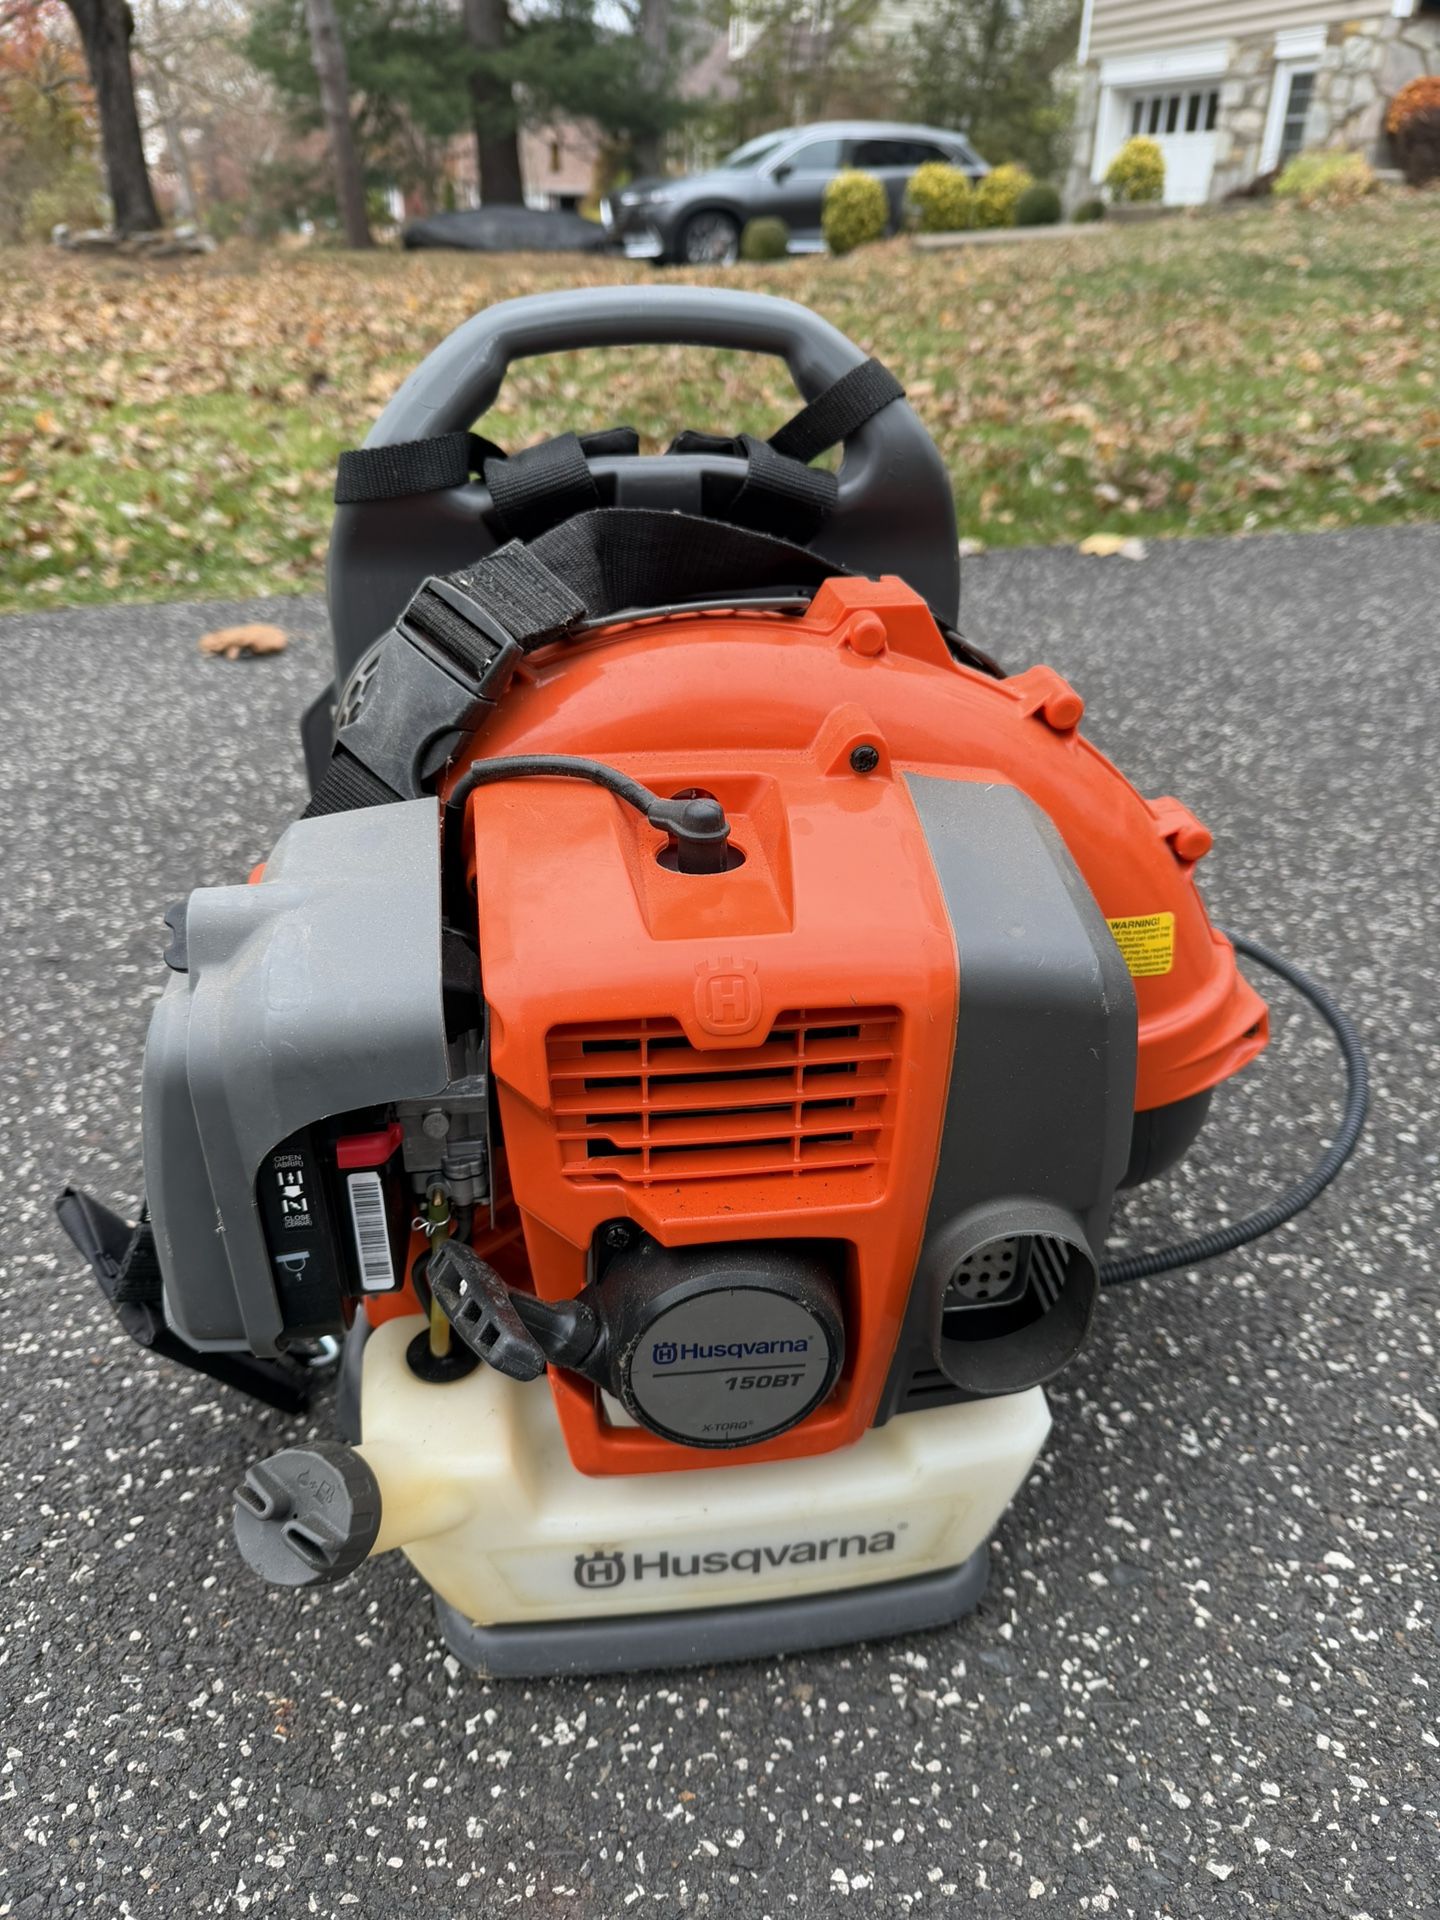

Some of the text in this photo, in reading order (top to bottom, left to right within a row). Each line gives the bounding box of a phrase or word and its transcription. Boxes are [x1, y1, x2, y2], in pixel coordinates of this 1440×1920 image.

[1111, 917, 1160, 929] WARNING!
[680, 1338, 808, 1360] Husqvarna
[725, 1373, 805, 1391] 150BT
